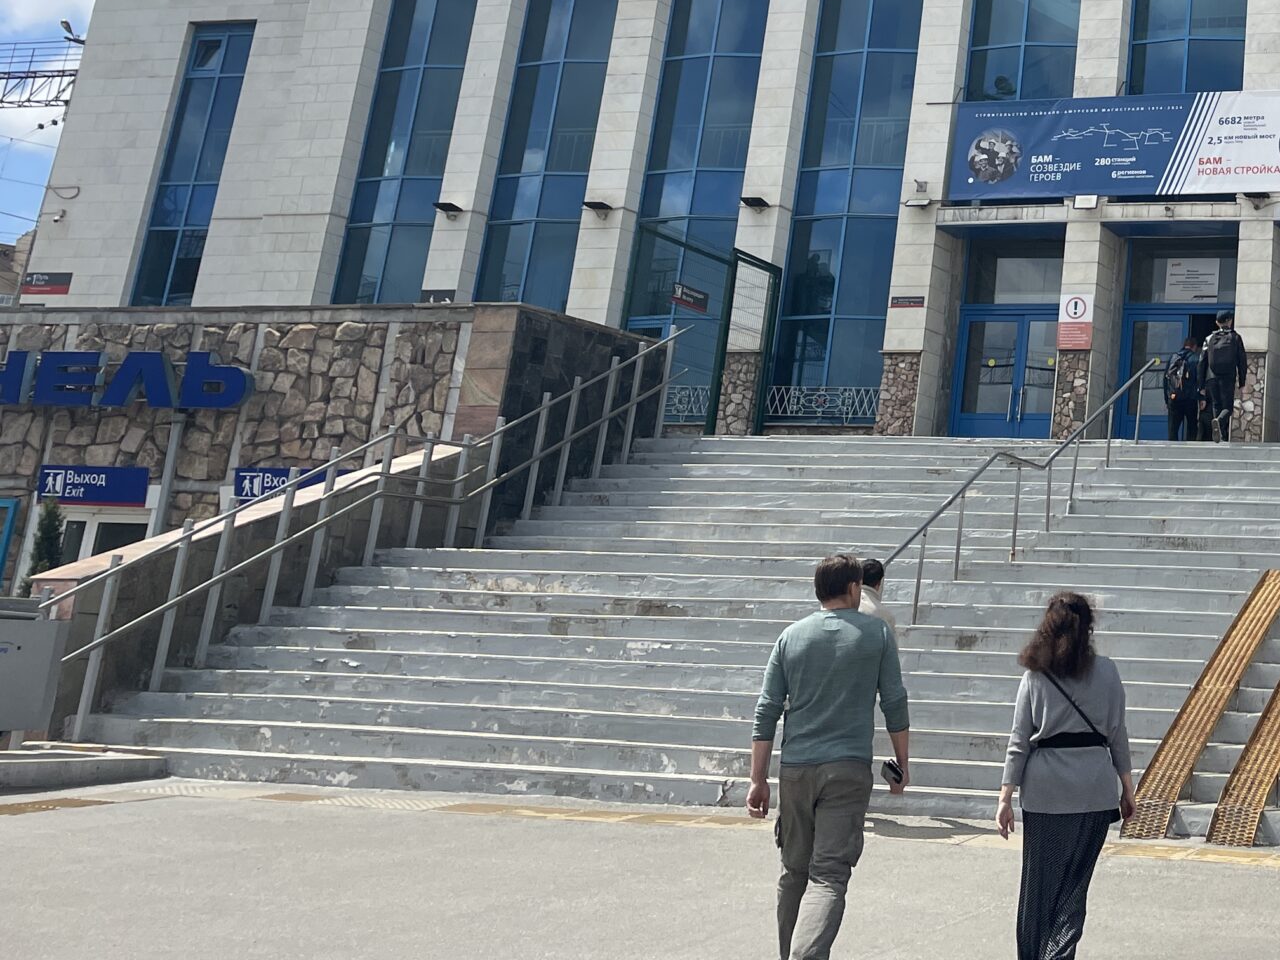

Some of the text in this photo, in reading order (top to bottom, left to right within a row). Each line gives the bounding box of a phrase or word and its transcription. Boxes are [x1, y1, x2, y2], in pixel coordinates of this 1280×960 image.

[1218, 116, 1242, 126] 6682
[1207, 136, 1223, 146] 2,5
[1031, 154, 1053, 164] БАМ
[1094, 157, 1111, 166] 280
[1198, 157, 1223, 166] БАМ
[1030, 162, 1082, 173] СОЗВЕЗДИЕ
[1197, 163, 1280, 177] НОВАЯ СТРОЙКА
[1029, 172, 1062, 182] ГЕРОЕВ
[1111, 170, 1117, 179] 6
[66, 470, 106, 487] Выход
[263, 473, 288, 488] Вхо
[64, 485, 85, 499] Exit
